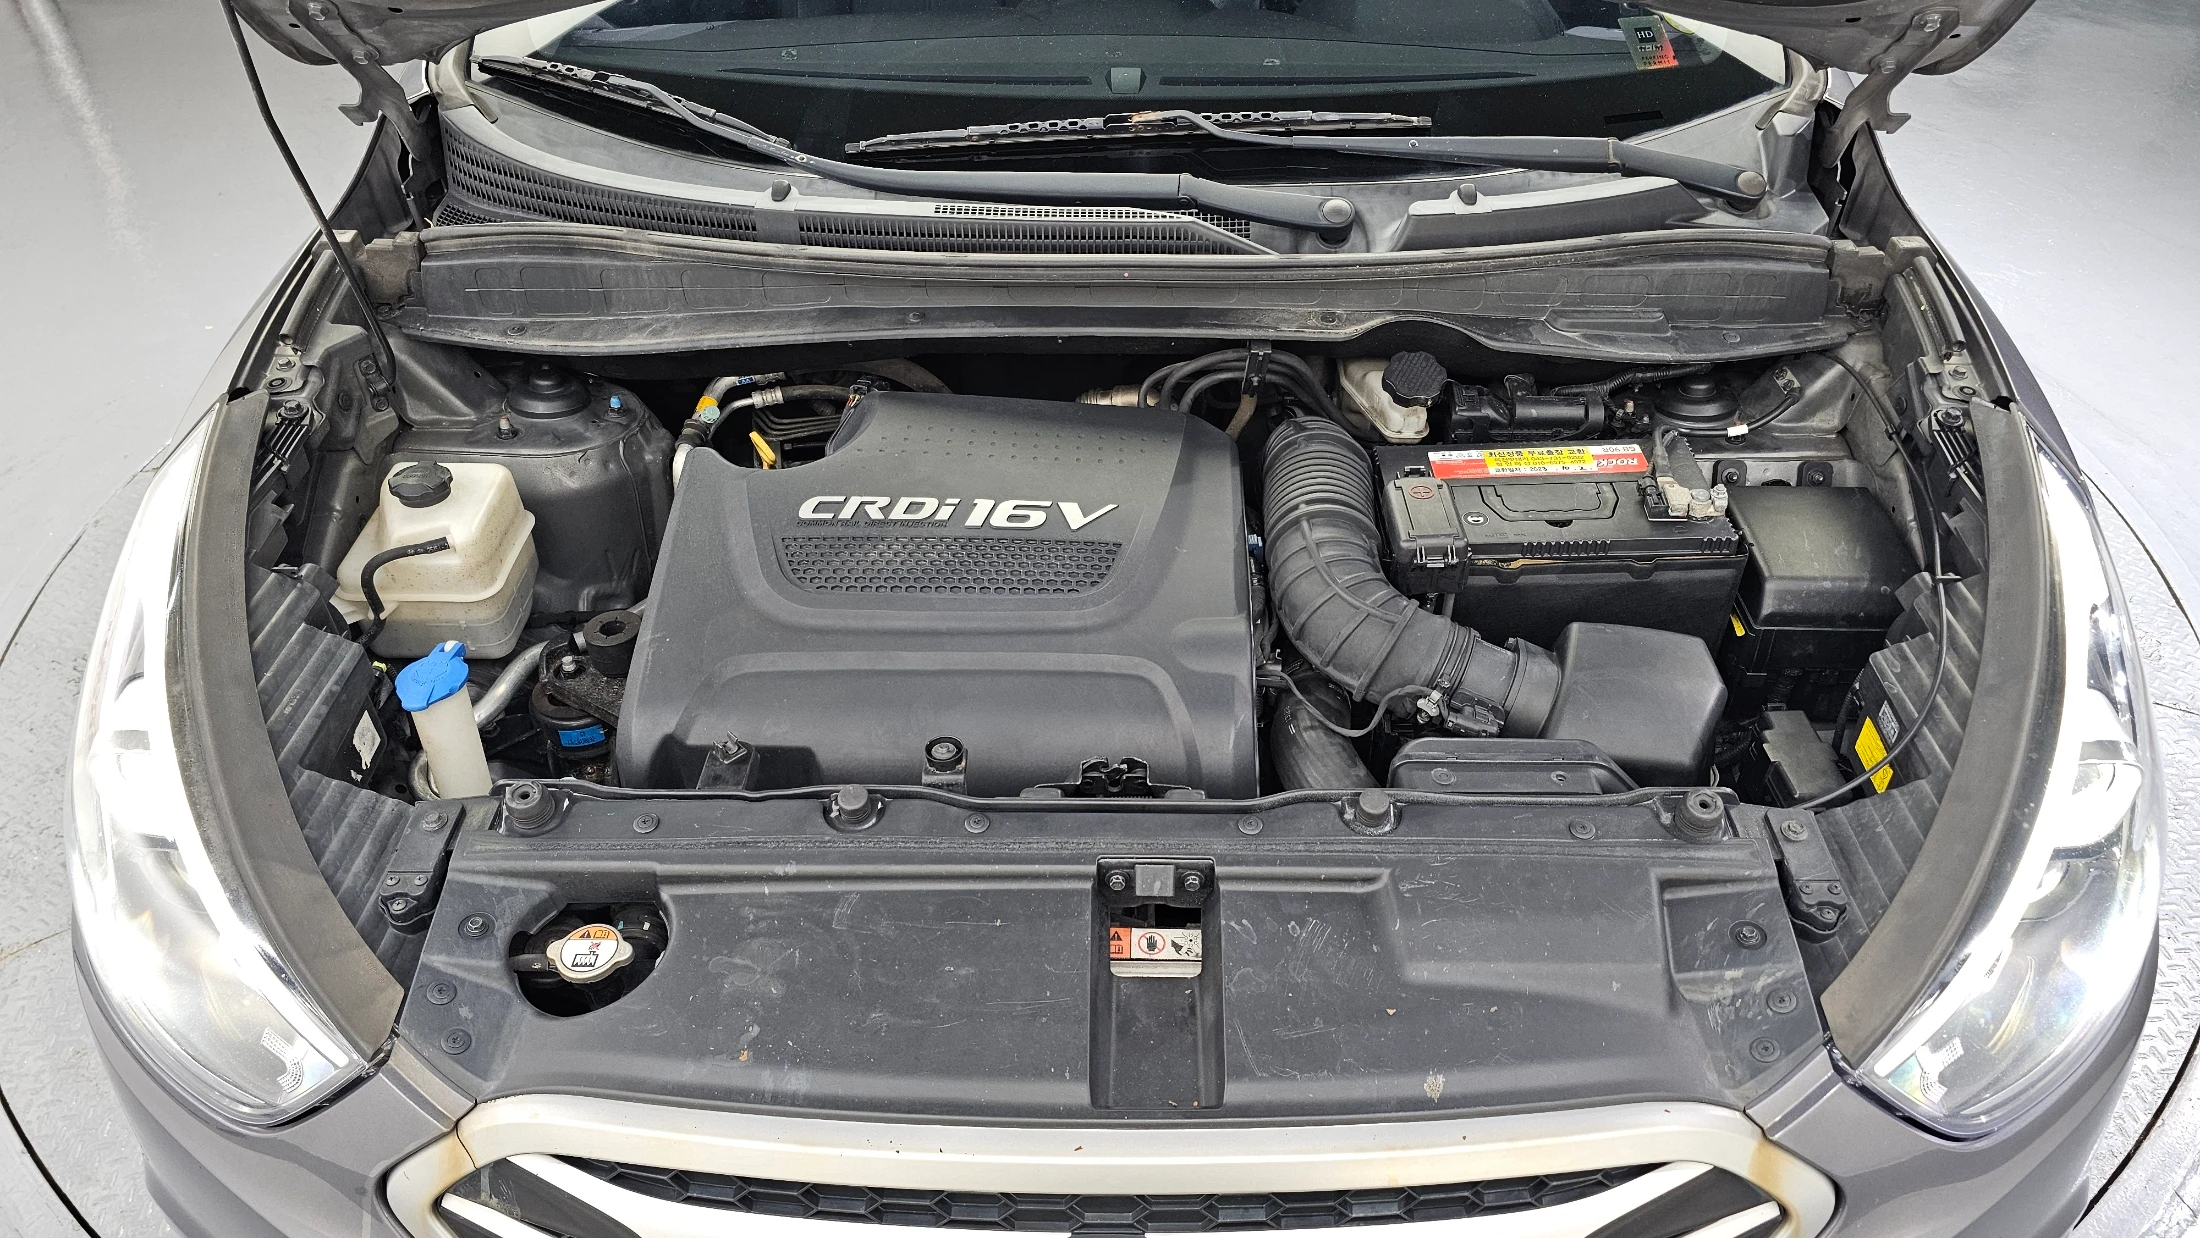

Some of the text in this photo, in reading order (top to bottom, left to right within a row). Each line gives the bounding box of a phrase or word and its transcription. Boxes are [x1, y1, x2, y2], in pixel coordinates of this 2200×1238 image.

[1636, 30, 1654, 39] HD
[798, 495, 962, 521] CRDi
[796, 519, 948, 529] COMMON RAIL DIRECT INJECTION
